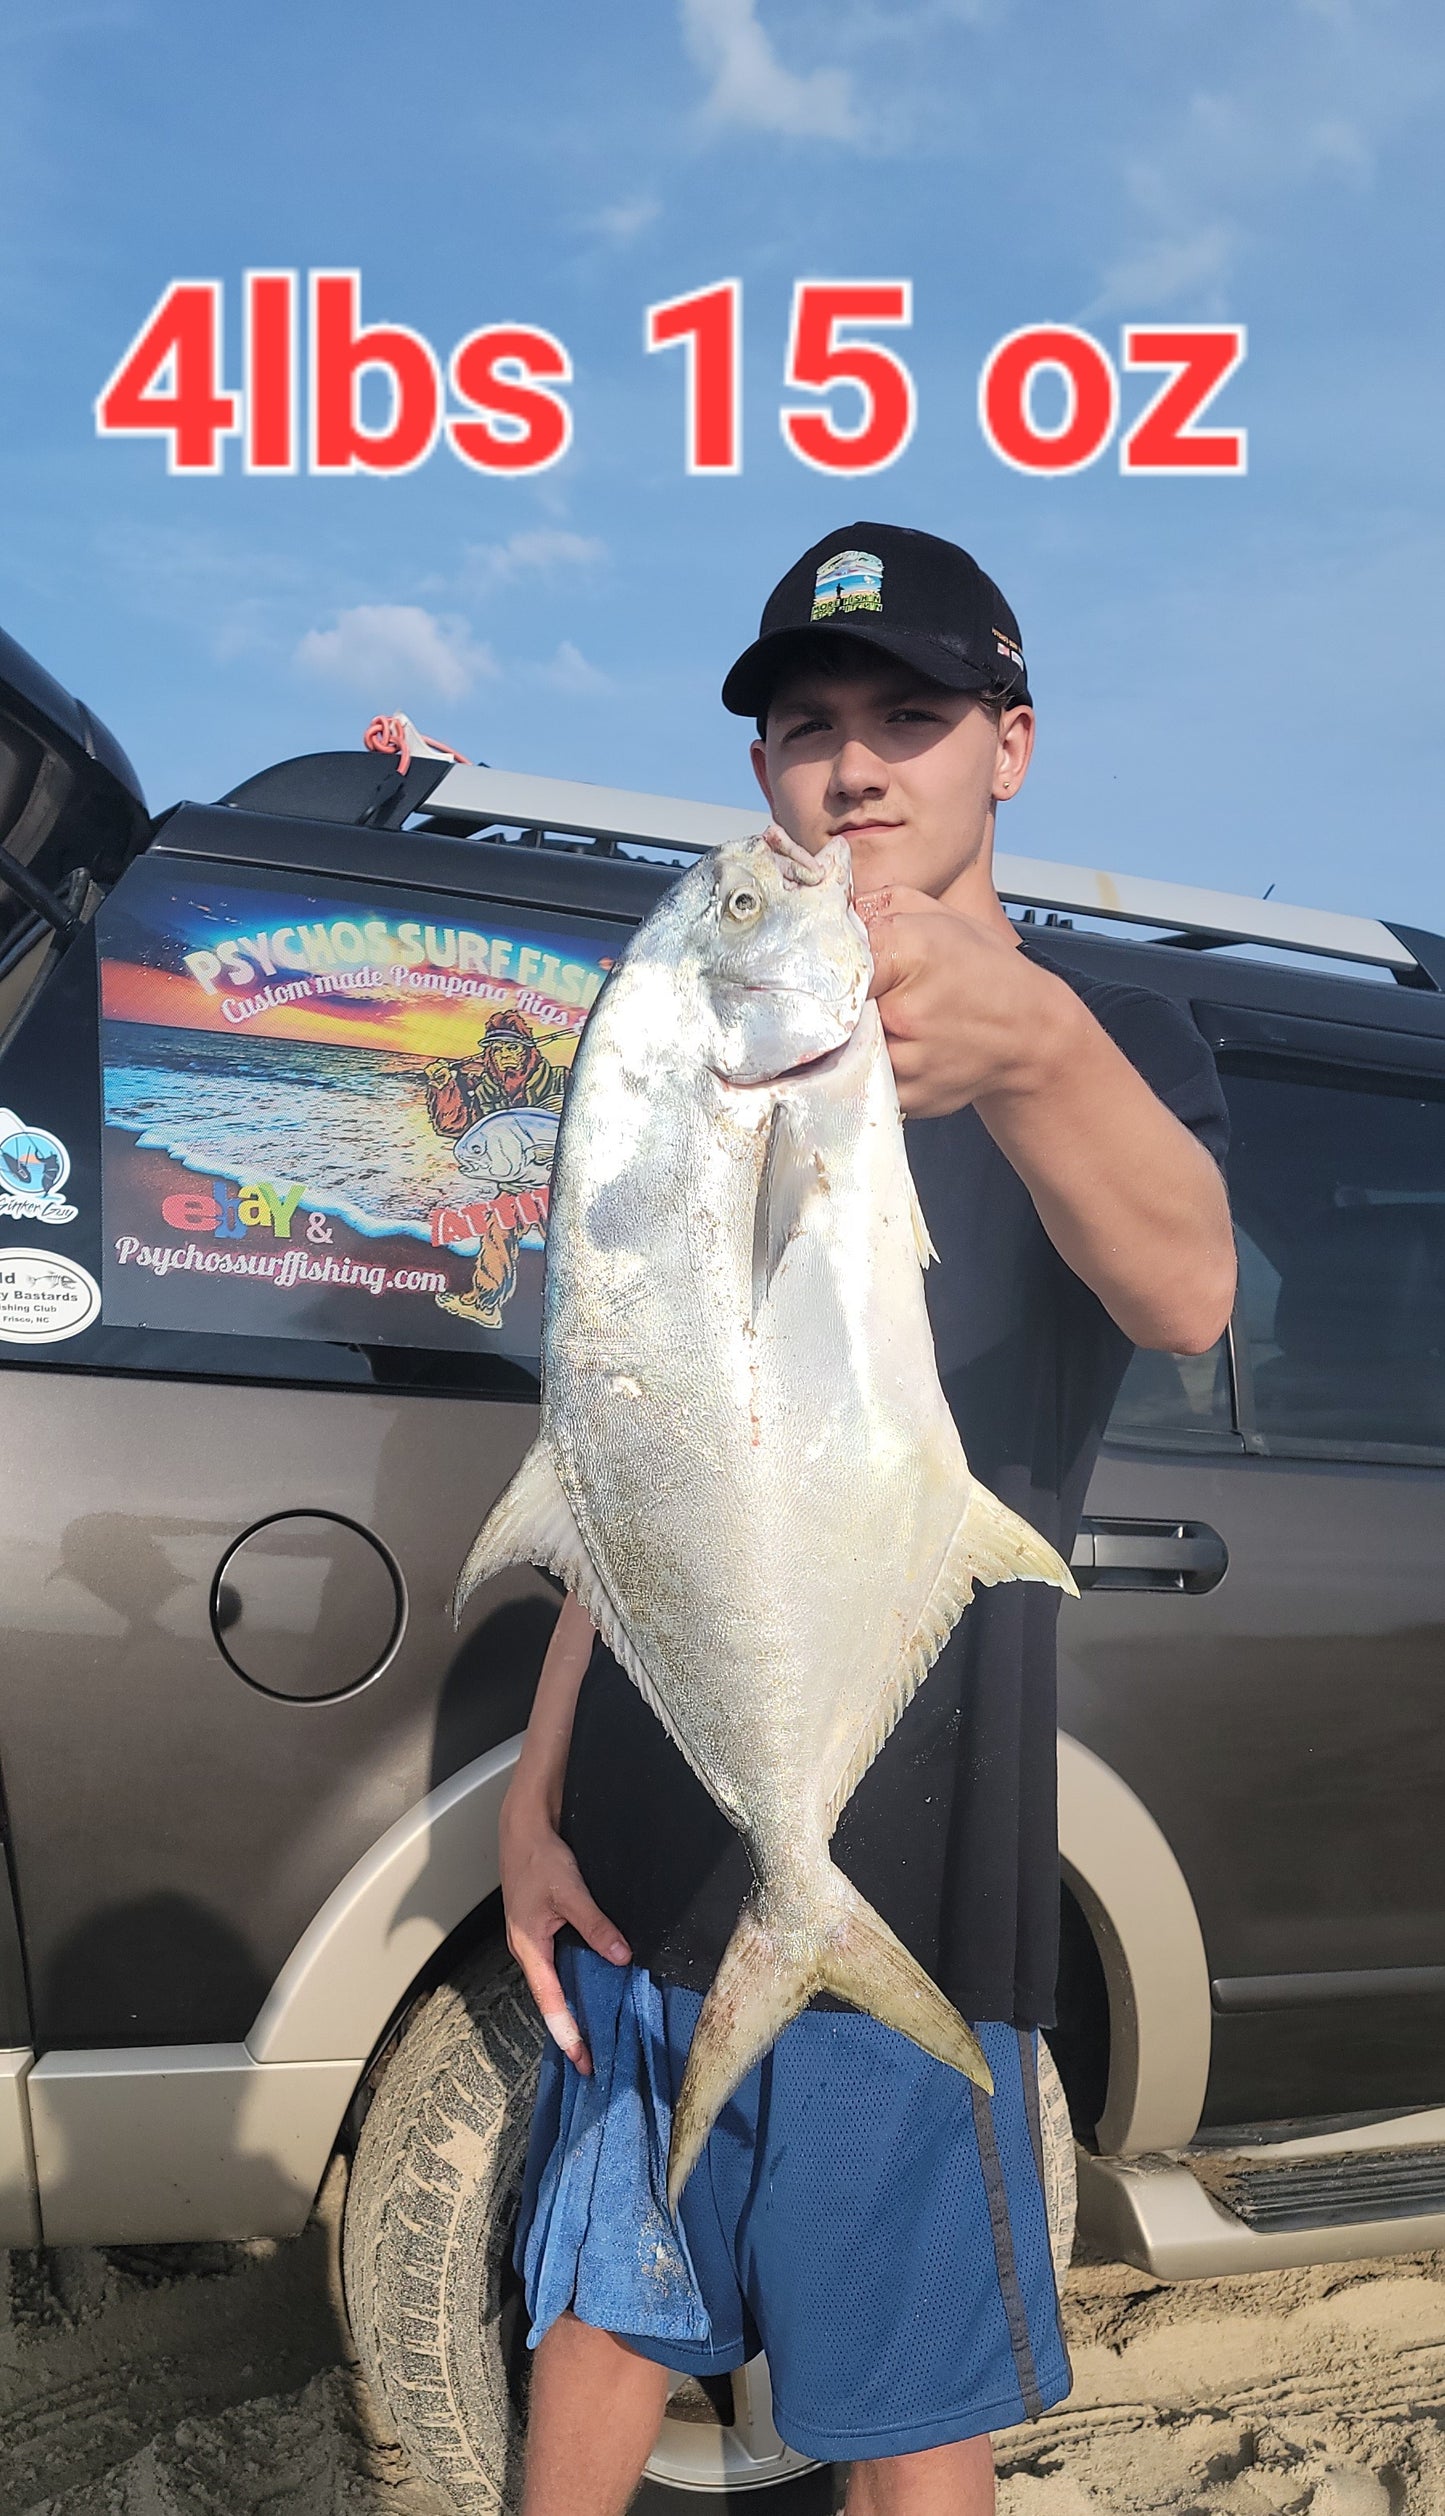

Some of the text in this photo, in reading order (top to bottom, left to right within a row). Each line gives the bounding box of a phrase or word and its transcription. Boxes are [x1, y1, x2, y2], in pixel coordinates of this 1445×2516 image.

[183, 921, 388, 996] PSYCHOS
[397, 923, 513, 977] SURF
[220, 979, 313, 1024] Custom
[315, 966, 384, 994] made
[390, 964, 509, 1001] Pompano
[515, 988, 569, 1026] Rigs
[306, 1212, 334, 1245] &
[114, 1236, 446, 1295] Psychossurffishing.com
[14, 1290, 79, 1302] Bastards
[33, 1305, 57, 1313] Club
